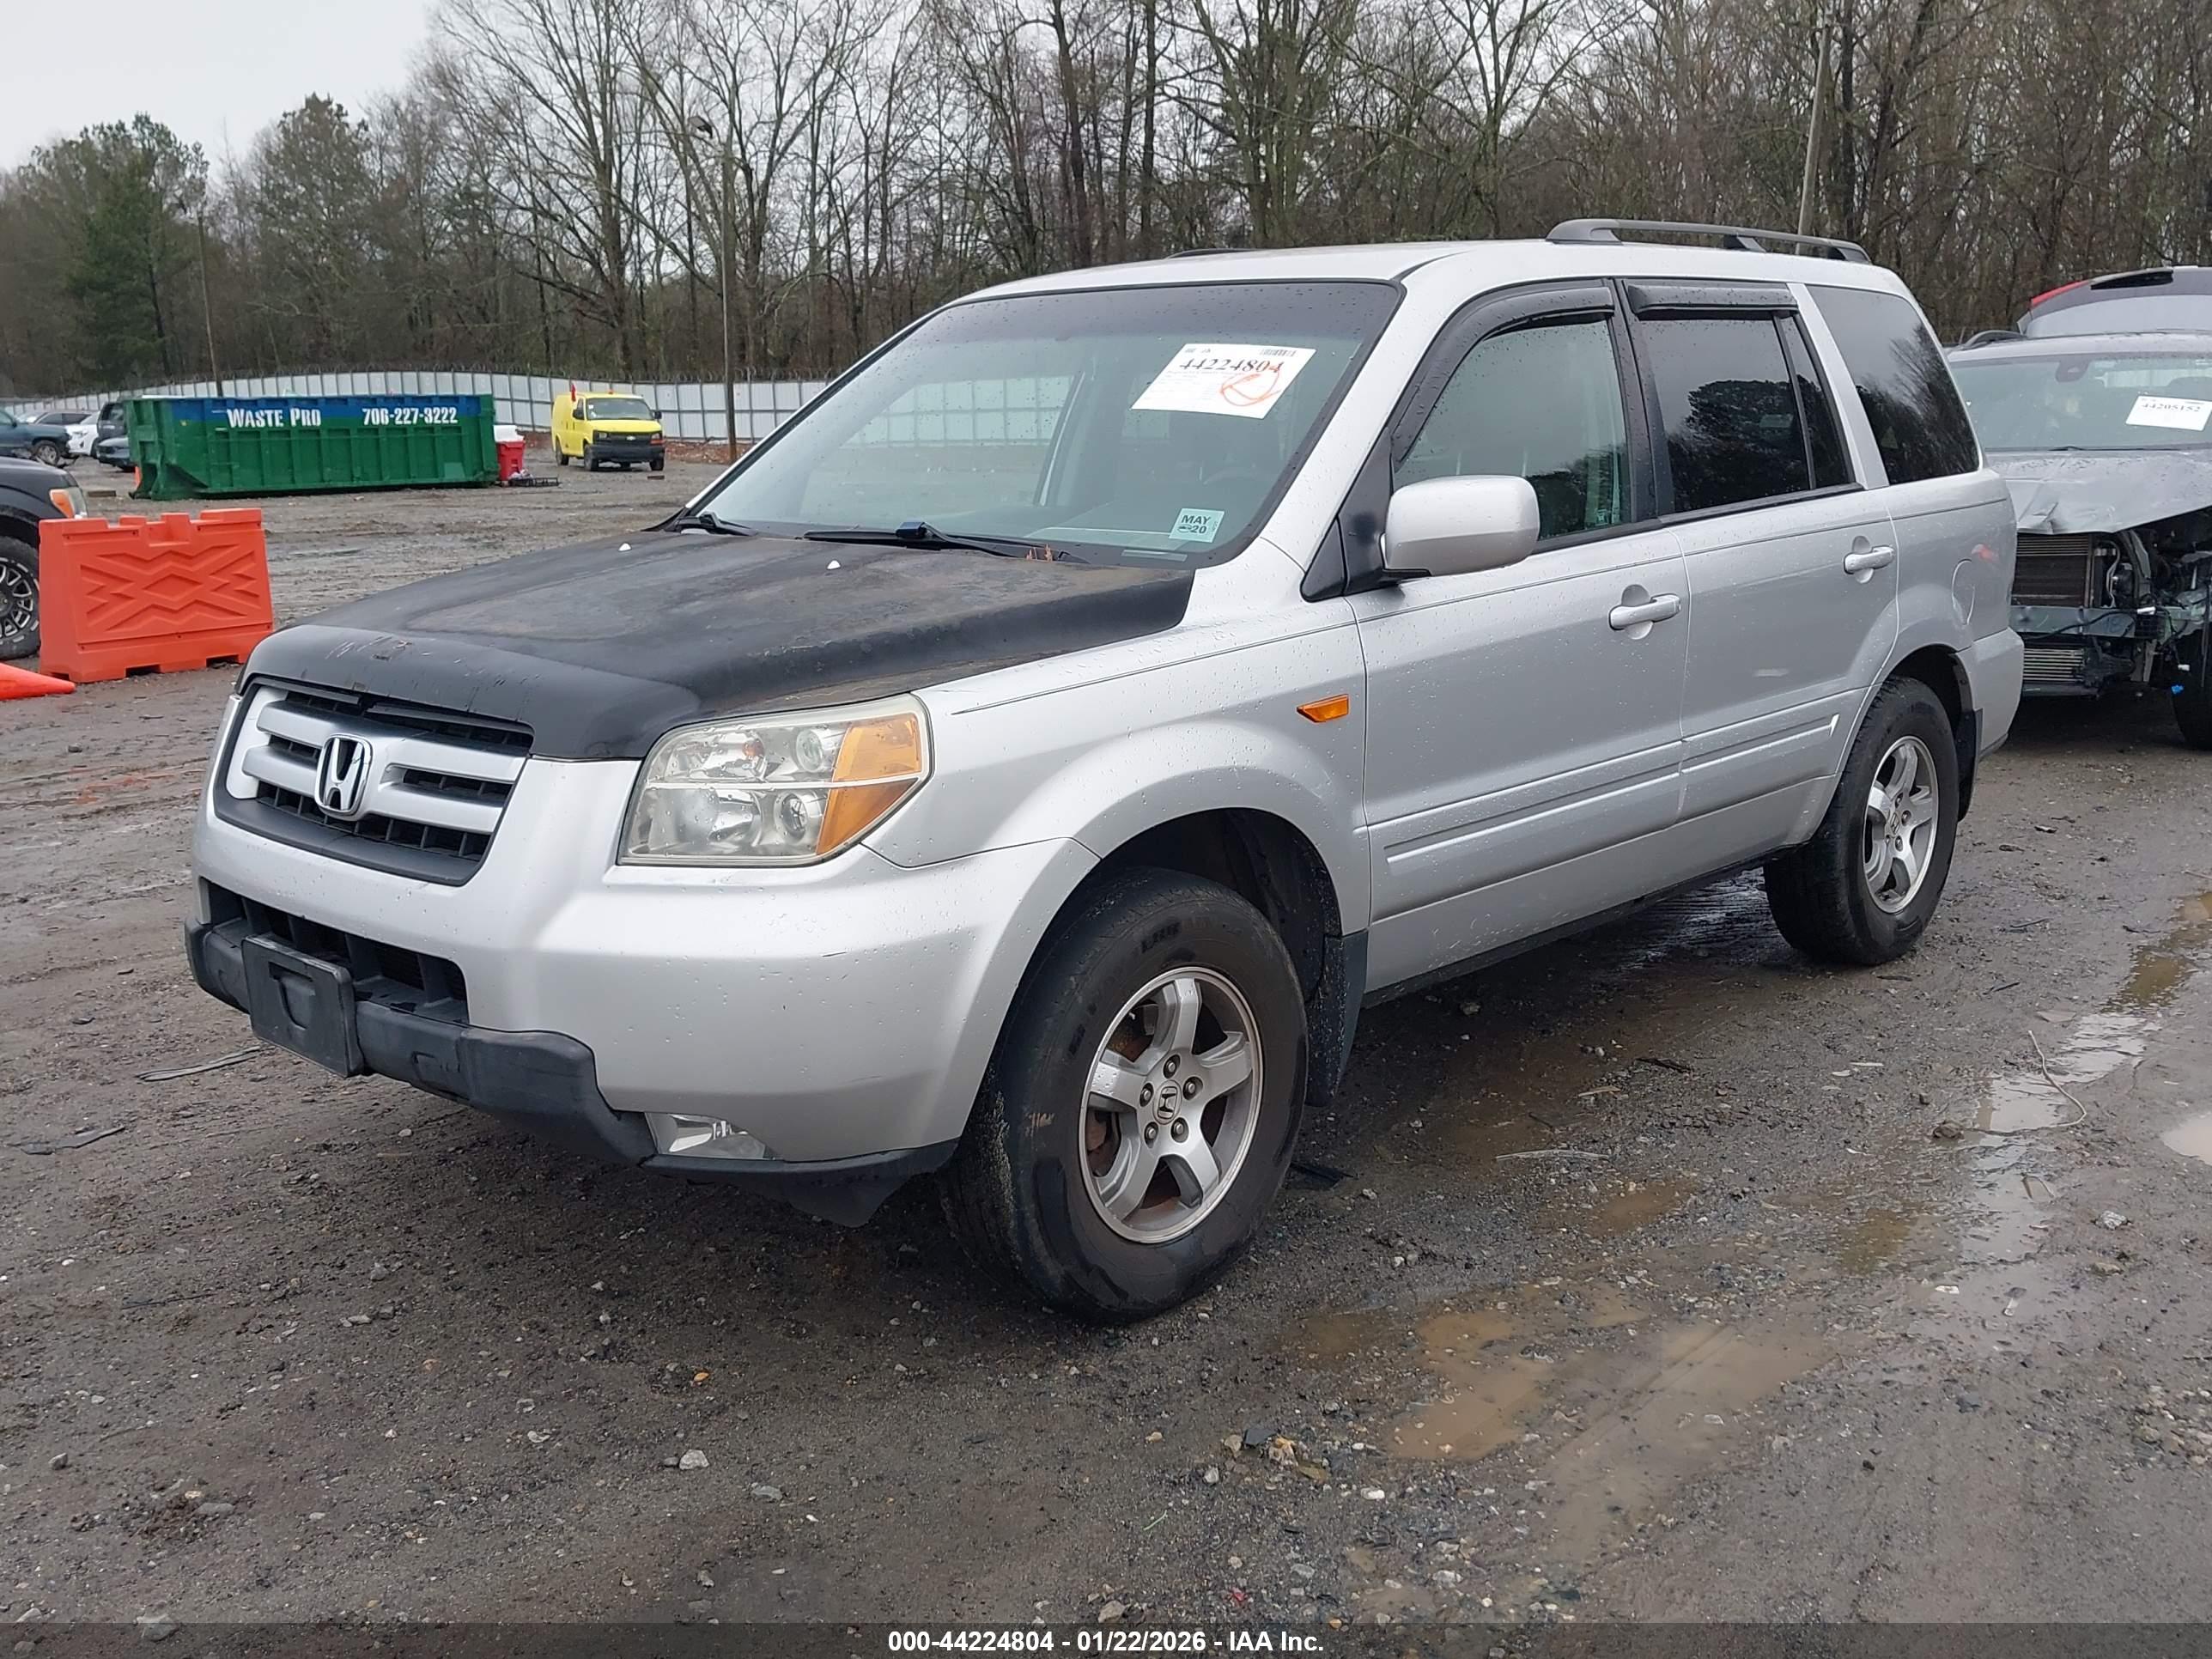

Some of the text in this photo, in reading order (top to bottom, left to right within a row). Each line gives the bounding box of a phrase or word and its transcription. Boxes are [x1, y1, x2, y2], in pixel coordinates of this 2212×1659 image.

[1179, 357, 1285, 374] 44224804
[227, 407, 322, 428] WASTE PRO
[362, 406, 459, 426] 706-227-3222
[1181, 514, 1212, 525] MAY
